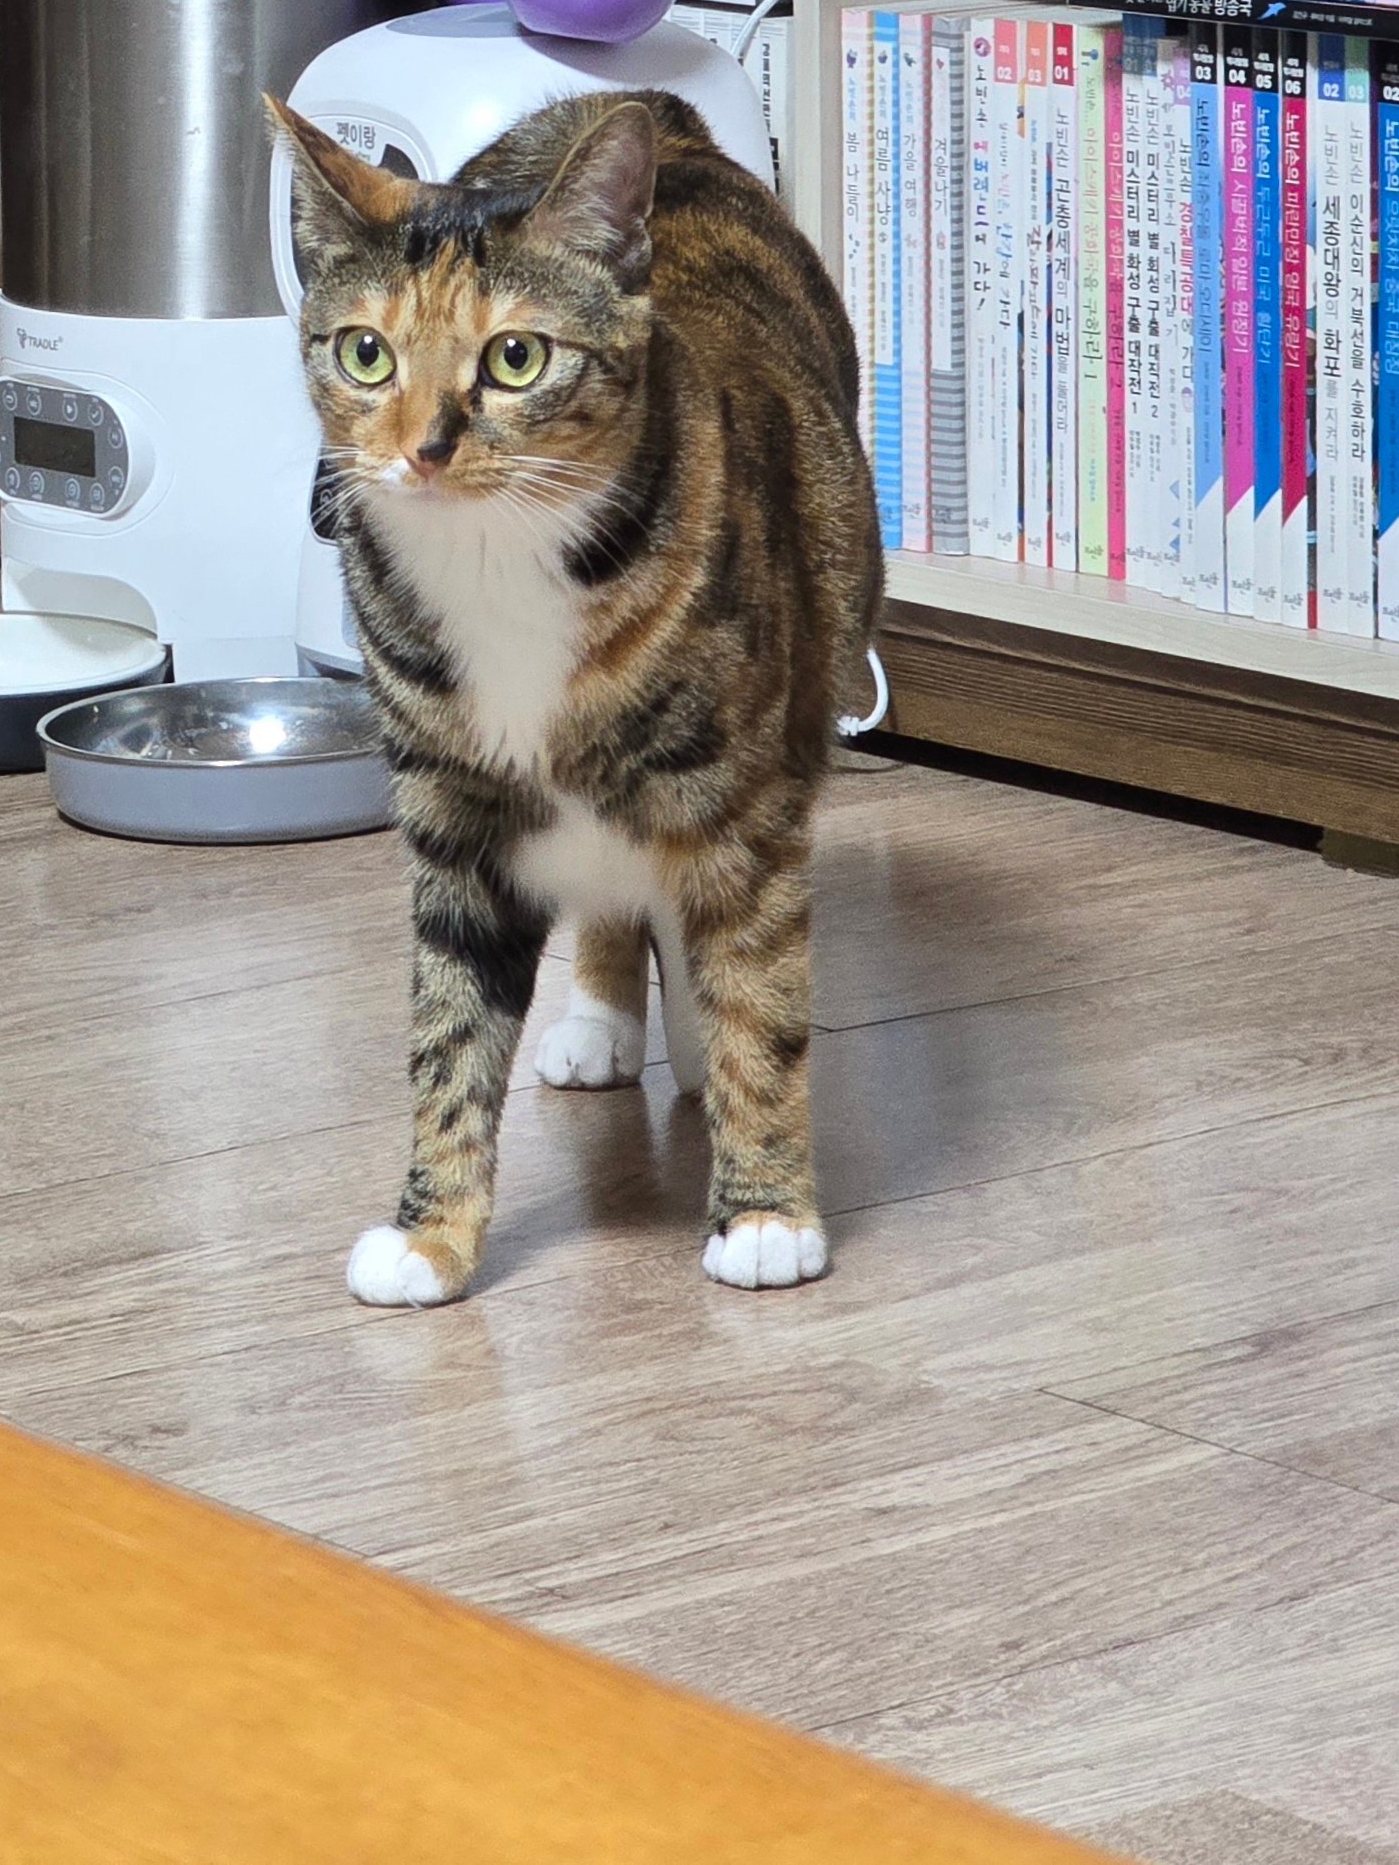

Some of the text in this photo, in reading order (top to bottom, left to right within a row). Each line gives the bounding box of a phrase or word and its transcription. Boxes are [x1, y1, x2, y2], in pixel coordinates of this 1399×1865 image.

[1214, 0, 1253, 17] 방송국
[997, 66, 1012, 80] 02
[1054, 65, 1070, 80] 01
[1195, 66, 1211, 80] 03
[1256, 74, 1272, 89] 05
[1323, 83, 1340, 97] 02
[336, 121, 377, 150] 펫이랑
[846, 132, 860, 224] 봄 나들이
[875, 127, 891, 226] 여름 사냥
[903, 133, 918, 218] 가을 여행
[934, 138, 949, 217] 겨울나기
[1229, 69, 1249, 353] 04 시끌벅적 일본 원정기
[1256, 185, 1271, 257] 두근두근
[1284, 79, 1301, 368] 06 영국 유랑기
[1125, 149, 1143, 397] 미스터리 별 화성 구출 대작전
[1147, 152, 1160, 399] 미스터리 구출 대작전
[1257, 264, 1271, 301] 미국
[1322, 195, 1341, 318] 세종대왕의
[1198, 286, 1213, 353] 오디세이
[1349, 193, 1366, 462] 이순신의 거북선을 수호하라
[1385, 276, 1399, 313] 중국
[28, 337, 60, 351] TRADLE
[1083, 298, 1103, 363] 구하라
[1323, 328, 1342, 399] 화포를
